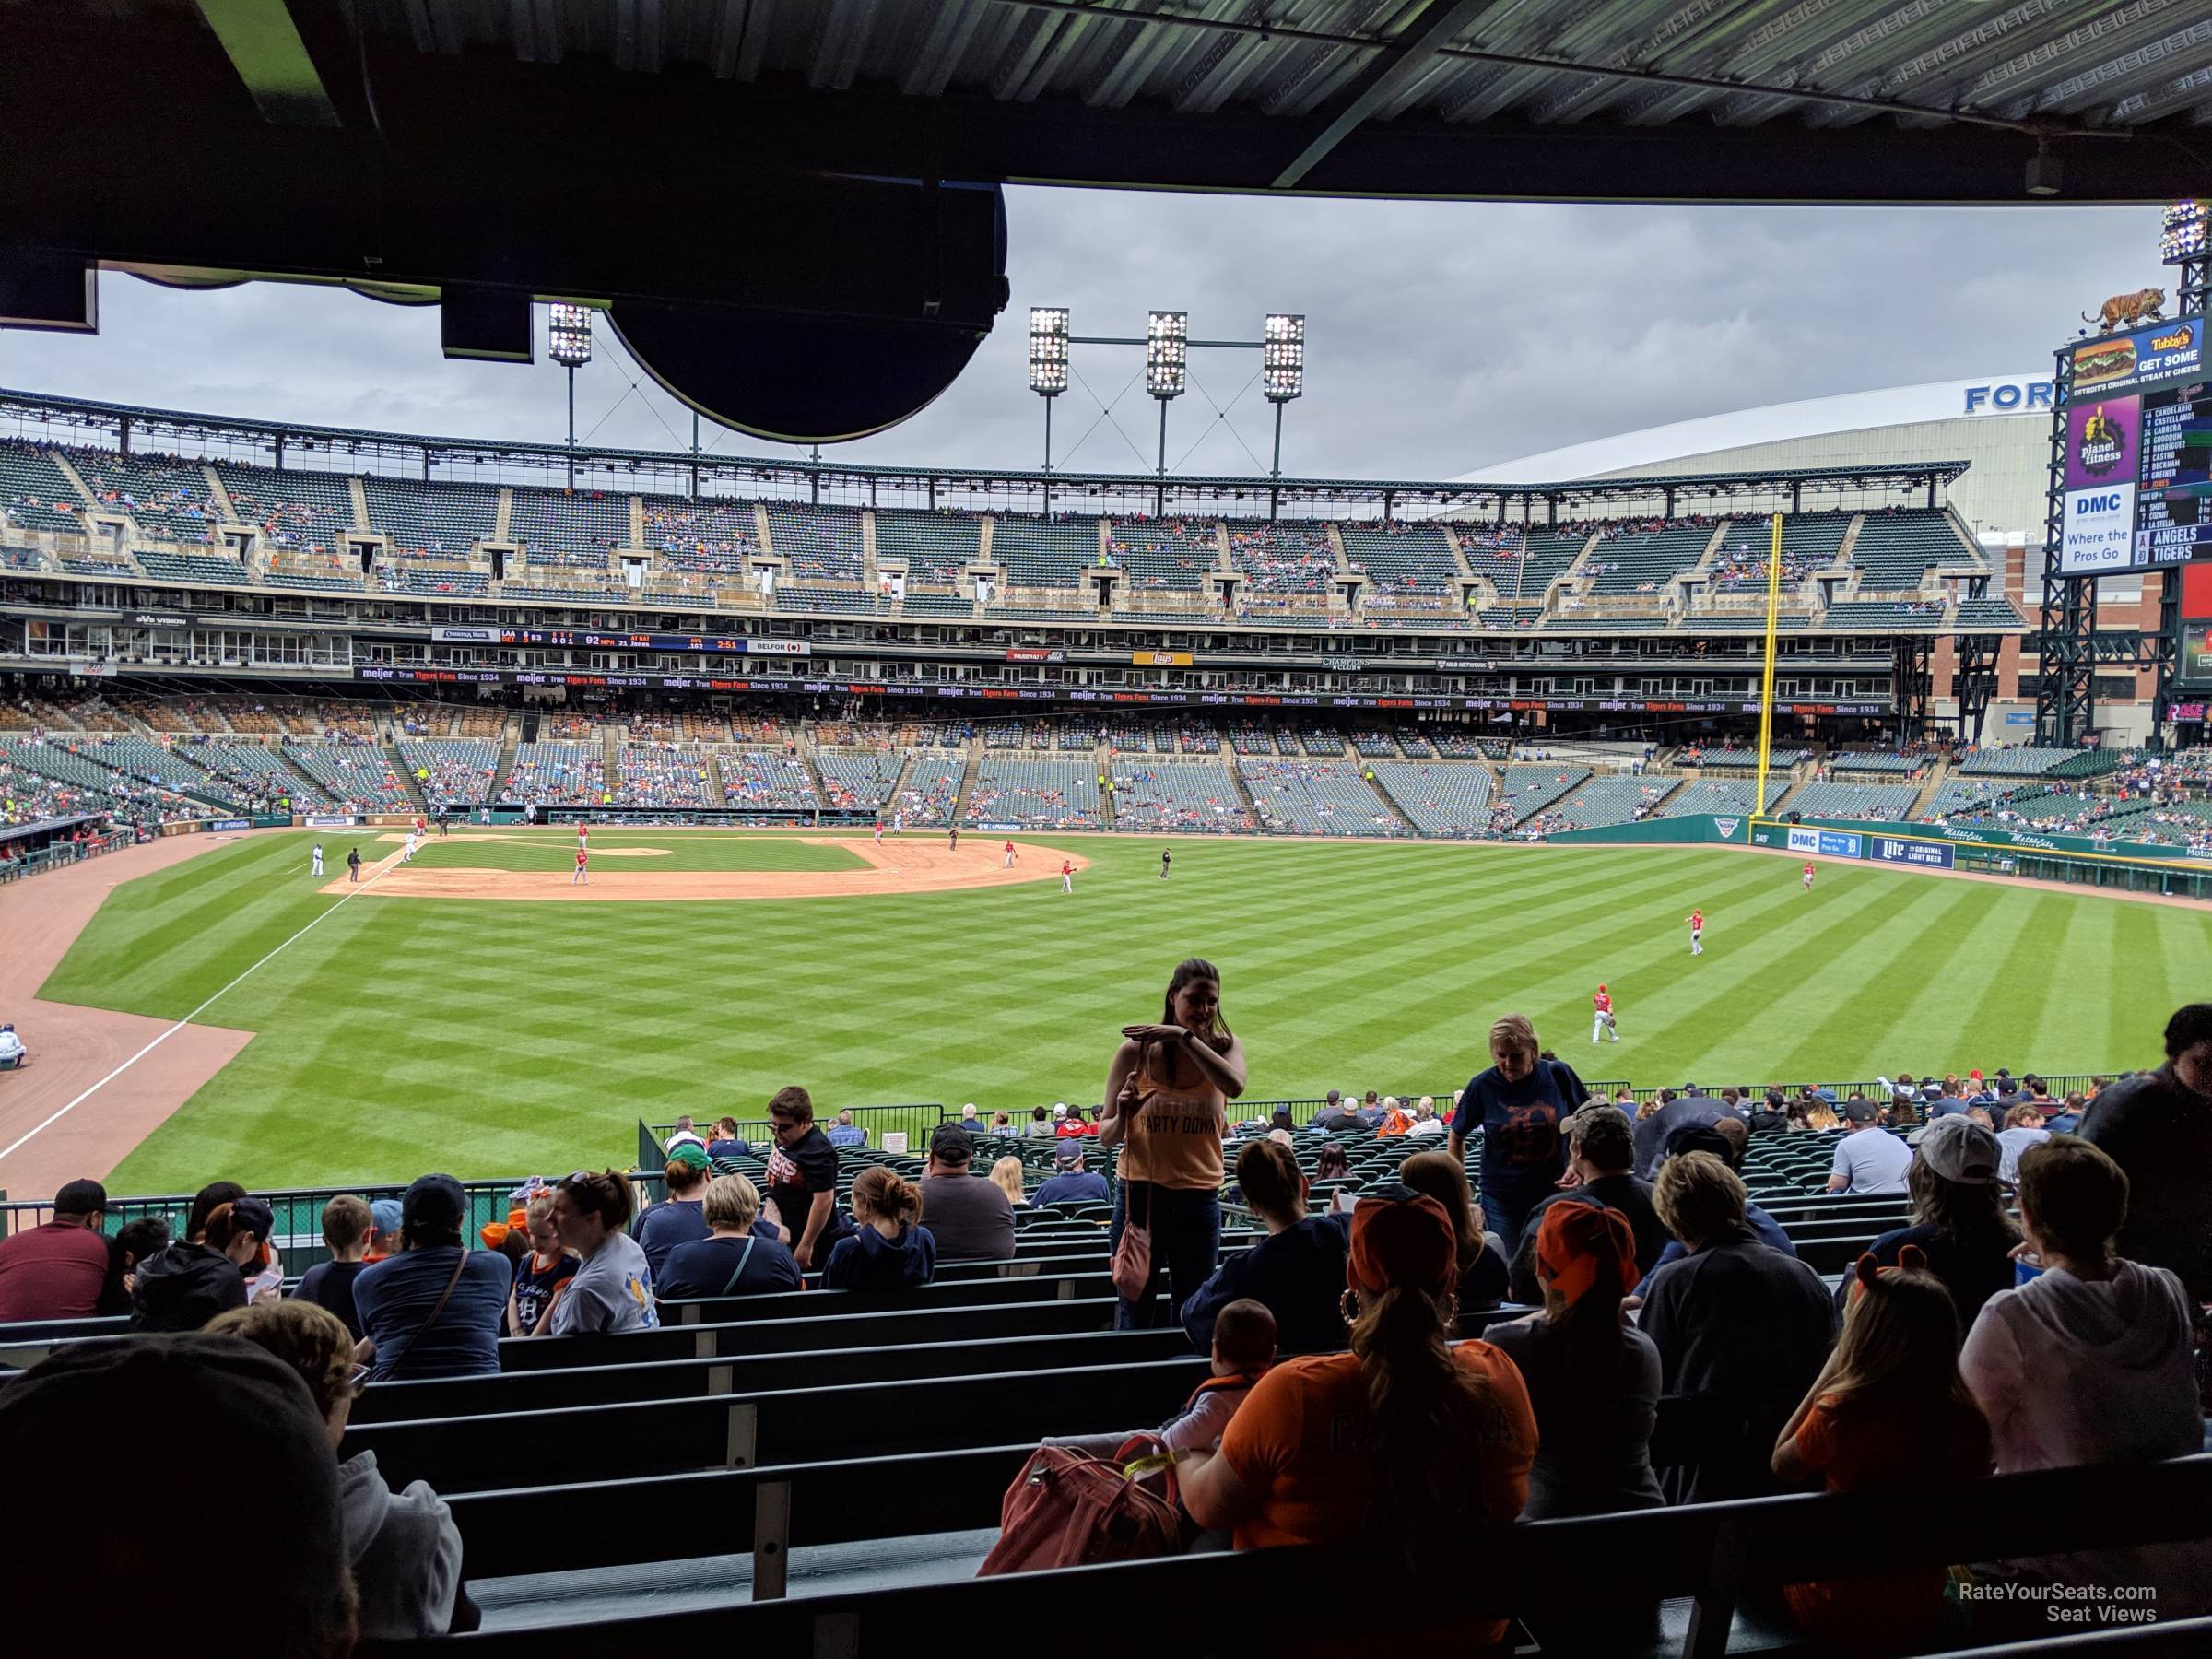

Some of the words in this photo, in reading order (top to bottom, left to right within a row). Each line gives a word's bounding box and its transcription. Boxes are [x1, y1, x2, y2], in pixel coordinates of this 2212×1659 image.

[2151, 332, 2189, 350] Tubby's
[2139, 358, 2162, 371] GET
[2164, 350, 2198, 366] SOME
[2074, 383, 2107, 396] DETROIT'S
[2107, 378, 2138, 389] ORIGINAL
[2140, 372, 2164, 382] STEAK
[2173, 363, 2201, 376] CHEESE
[1964, 382, 2053, 413] FOR
[2155, 404, 2192, 417] CANDELARIO
[2155, 412, 2195, 426] CASTELLANOS
[2154, 423, 2181, 435] CABRERA
[2153, 432, 2183, 444] GOODRUM
[2081, 441, 2114, 458] planet
[2085, 451, 2121, 465] fitness
[2152, 451, 2175, 461] CASTRO
[2152, 459, 2180, 470] BECKHAM
[2077, 494, 2121, 514] DMC
[2068, 533, 2104, 546] Where
[2108, 529, 2127, 541] the
[2154, 527, 2197, 545] ANGELS
[2074, 551, 2098, 562] Pros
[2102, 547, 2119, 559] Go
[2153, 545, 2192, 562] TIGERS
[585, 636, 599, 644] 92
[363, 668, 393, 679] meijer
[416, 671, 437, 681] Tigers
[516, 674, 546, 684] meijer
[566, 676, 587, 685] Tigers
[664, 677, 691, 688] meijer
[711, 680, 732, 689] Tigers
[733, 681, 749, 689] Fans
[804, 682, 830, 693] meijer
[849, 685, 868, 693] Tigers
[938, 687, 964, 697] meijer
[982, 689, 1002, 698] Tigers
[1070, 691, 1096, 701] meijer
[1114, 693, 1133, 702] Tigers
[1333, 696, 1359, 706] meijer
[1377, 699, 1396, 708] Tigers
[1465, 699, 1491, 709] meijer
[1511, 701, 1530, 710] Tigers
[1531, 701, 1546, 710] Fans
[1599, 700, 1627, 711] meijer
[1646, 702, 1666, 712] Tigers
[1668, 702, 1684, 711] Fans
[1743, 702, 1762, 713] meij
[1793, 704, 1815, 714] Tigers
[1817, 705, 1834, 713] Fans
[2168, 704, 2204, 721] ROSE
[1792, 834, 1816, 847] DMC
[1883, 841, 1904, 859] Lite
[1915, 846, 1942, 855] ORIGINAL
[2186, 848, 2211, 856] Moto
[1908, 853, 1924, 861] LIGHT
